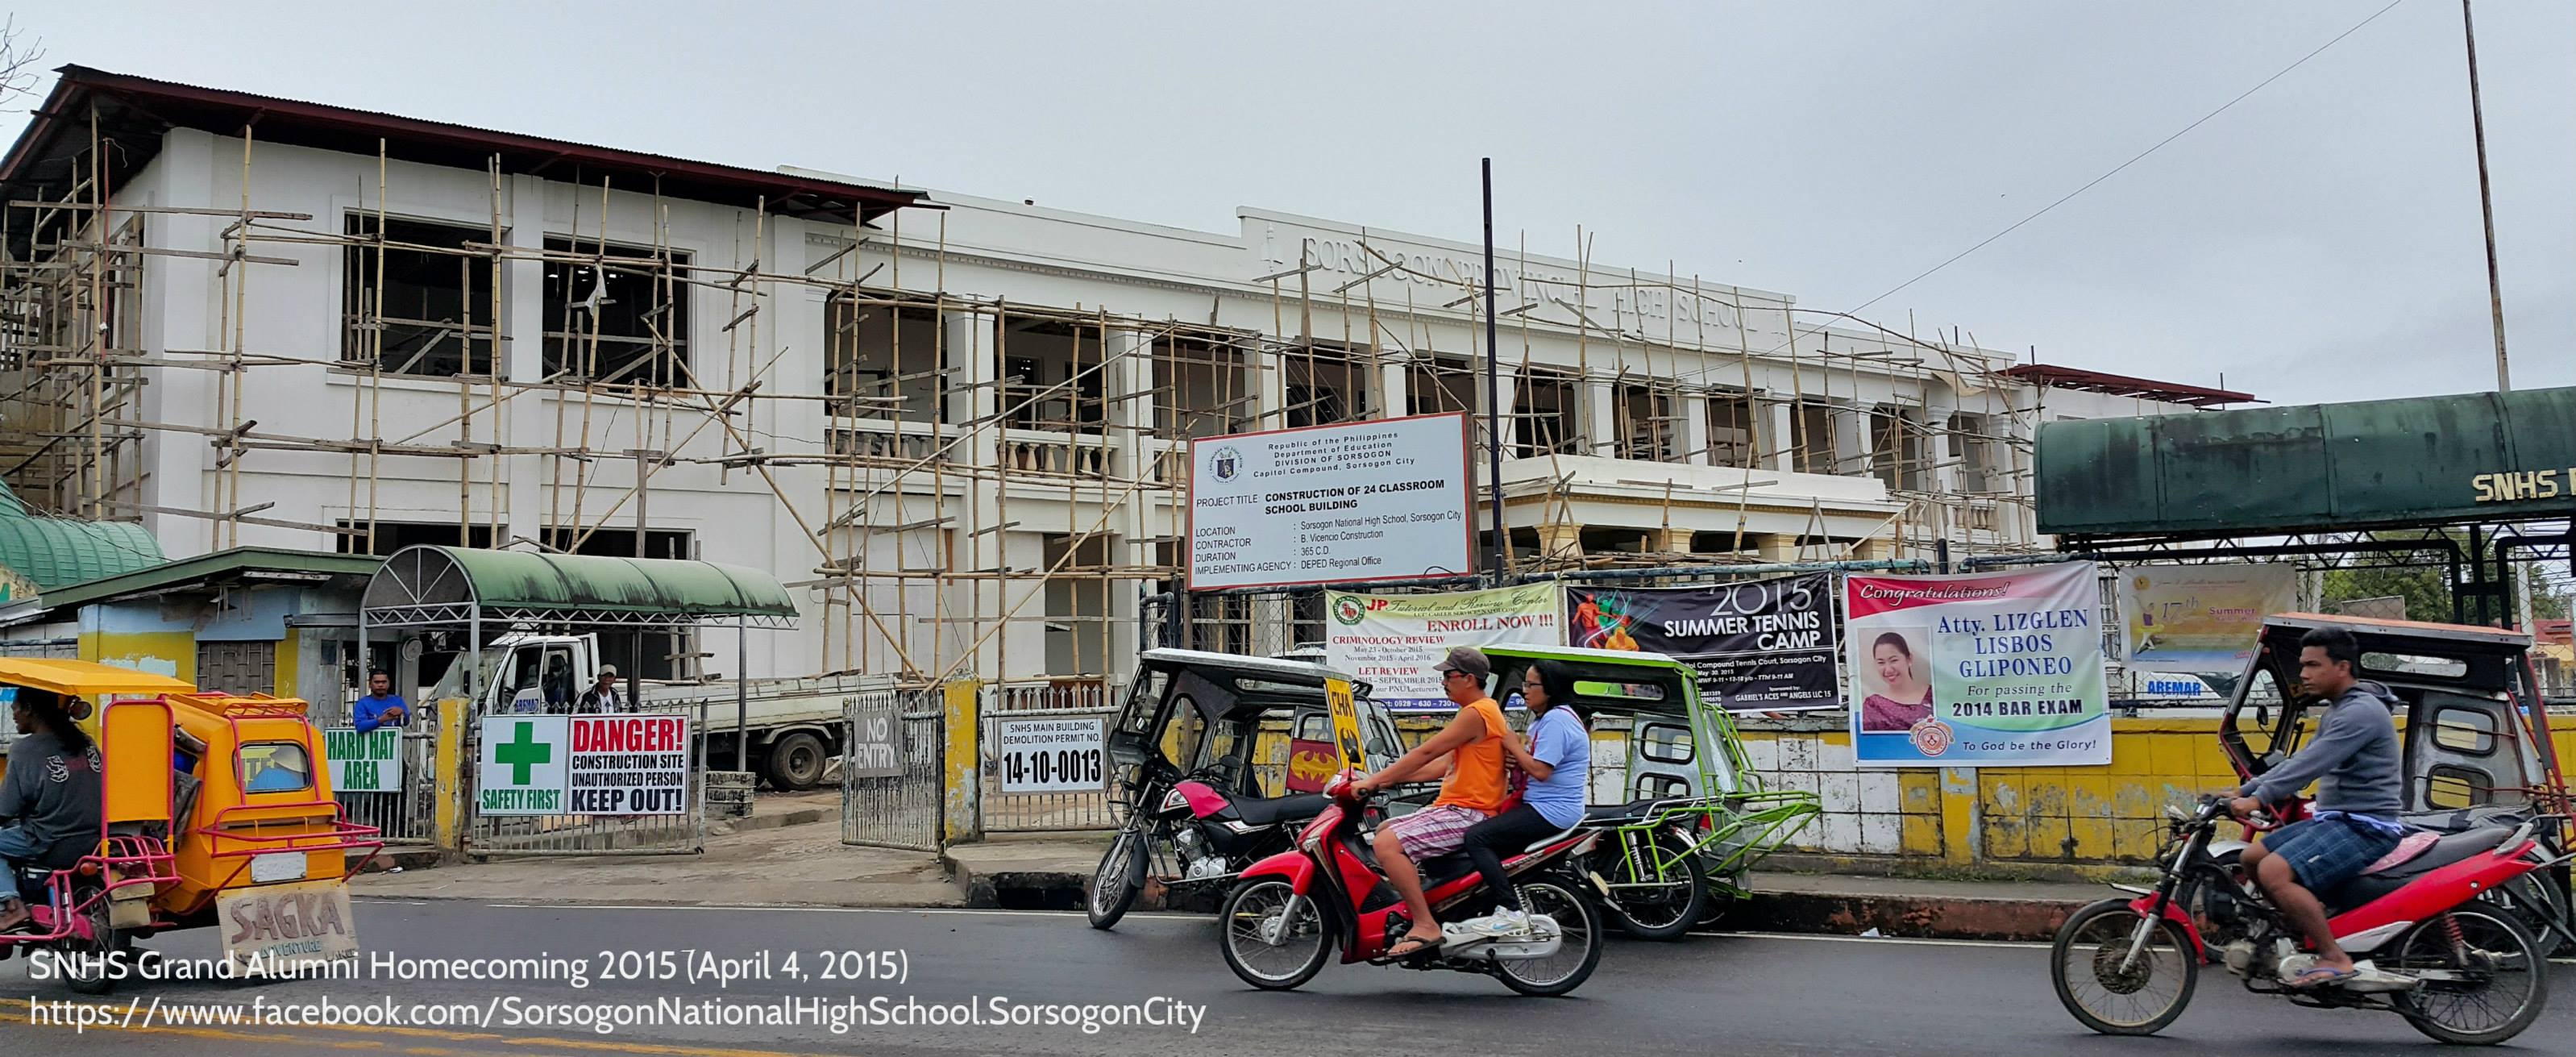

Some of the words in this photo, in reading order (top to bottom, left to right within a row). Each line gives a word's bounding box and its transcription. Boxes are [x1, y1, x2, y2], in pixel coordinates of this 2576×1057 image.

[1612, 288, 1665, 319] HIGH
[1676, 293, 1758, 332] SCHOOL
[1269, 441, 1307, 452] Republic
[1344, 432, 1398, 444] Philippines
[1274, 447, 1327, 460] Department
[1344, 442, 1392, 452] Education
[1253, 469, 1286, 478] Capitol
[1290, 464, 1342, 474] Compound,
[1346, 460, 1391, 470] Sorsogon
[1395, 457, 1415, 465] City
[1275, 457, 1316, 467] DIVISION
[1337, 450, 1392, 461] SORSOGON
[1196, 496, 1235, 508] PROJECT
[1265, 487, 1344, 502] CONSTRUCTION
[1348, 486, 1361, 496] OF
[1364, 485, 1376, 494] 24
[1379, 479, 1445, 493] CLASSROOM
[2472, 469, 2558, 501] SNHS
[1265, 504, 1306, 515] SCHOOL
[1309, 499, 1358, 512] BUILDING
[1195, 526, 1236, 538] LOCATION
[1301, 519, 1333, 531] Sorsogon
[1335, 516, 1363, 528] National
[1365, 515, 1381, 527] High
[1382, 514, 1408, 524] School,
[1410, 512, 1445, 523] Sorsogon
[1447, 510, 1462, 522] City
[1195, 538, 1252, 550] CONTRACTOR
[1301, 535, 1308, 543] B.
[1310, 533, 1339, 543] Vicencio
[1340, 529, 1384, 541] Construction
[1195, 551, 1236, 563] DURATION
[1301, 547, 1314, 556] 365
[1315, 545, 1331, 556] C.D.
[1195, 563, 1256, 575] IMPLEMENTING
[1257, 561, 1292, 572] AGENCY
[1301, 559, 1327, 570] DEPED
[1329, 557, 1360, 569] Regional
[1361, 556, 1382, 566] Office
[1366, 598, 1388, 611] JP
[1386, 599, 1437, 613] Tutorial
[1436, 600, 1458, 611] and
[1460, 596, 1503, 611] Review
[1510, 590, 1548, 605] Center
[1709, 577, 1813, 617] 2015
[1859, 581, 2010, 606] Congratulations!
[2208, 606, 2255, 615] Summer
[1427, 618, 1494, 633] ENROLL
[1496, 615, 1535, 630] NOW
[1664, 617, 1749, 638] SUMMER
[1752, 610, 1820, 633] TENNIS
[1937, 615, 1985, 636] Atty.
[1992, 609, 2089, 632] LIZGLEN
[1332, 635, 1403, 645] CRIMINOLOGY
[1405, 635, 1445, 644] REVIEW
[1354, 646, 1368, 654] May
[1757, 630, 1822, 651] CAMP
[1975, 634, 2053, 655] LISBOS
[1359, 667, 1379, 676] LET
[1380, 667, 1419, 676] REVIEW
[1697, 660, 1735, 669] Compound
[1735, 659, 1757, 667] Tennis
[1758, 658, 1779, 666] Court,
[1780, 656, 1812, 665] Sorsogon
[1813, 655, 1827, 664] City
[1959, 656, 2072, 678] GLIPONEO
[1735, 693, 1764, 702] GABRIEL'S
[1764, 693, 1780, 701] ACES
[1789, 691, 1812, 699] ANGELS
[1967, 685, 1990, 697] For
[1994, 683, 2045, 698] passing
[2050, 683, 2072, 693] the
[2147, 680, 2201, 696] AREMAR
[1953, 701, 1993, 718] 2014
[1999, 701, 2032, 716] BAR
[2038, 699, 2083, 715] EXAM
[573, 718, 684, 752] DANGER!
[866, 717, 888, 742] NO
[1010, 723, 1032, 733] SNHS
[1033, 722, 1054, 732] MAIN
[1056, 721, 1095, 732] BUILDING
[327, 731, 368, 760] HARD
[369, 730, 397, 760] HAT
[1003, 734, 1054, 745] DEMOLITION
[1055, 734, 1086, 743] PERMIT
[1086, 733, 1102, 743] NO.
[1963, 741, 1976, 751] To
[1981, 741, 2005, 751] God
[2010, 740, 2025, 751] be
[2030, 740, 2052, 751] the
[2057, 740, 2096, 752] Glory!
[572, 754, 658, 771] CONSTRUCTION
[659, 754, 684, 768] SITE
[858, 743, 895, 769] ENTRY
[1003, 748, 1102, 784] 14-10-0013
[343, 760, 380, 790] AREA
[571, 772, 644, 788] UNAUTHORIZED
[646, 772, 683, 787] PERSON
[483, 789, 525, 810] SAFETY
[526, 789, 561, 809] FIRST
[571, 789, 625, 812] KEEP
[630, 789, 683, 811] OUT!
[231, 892, 345, 944] SAGKA
